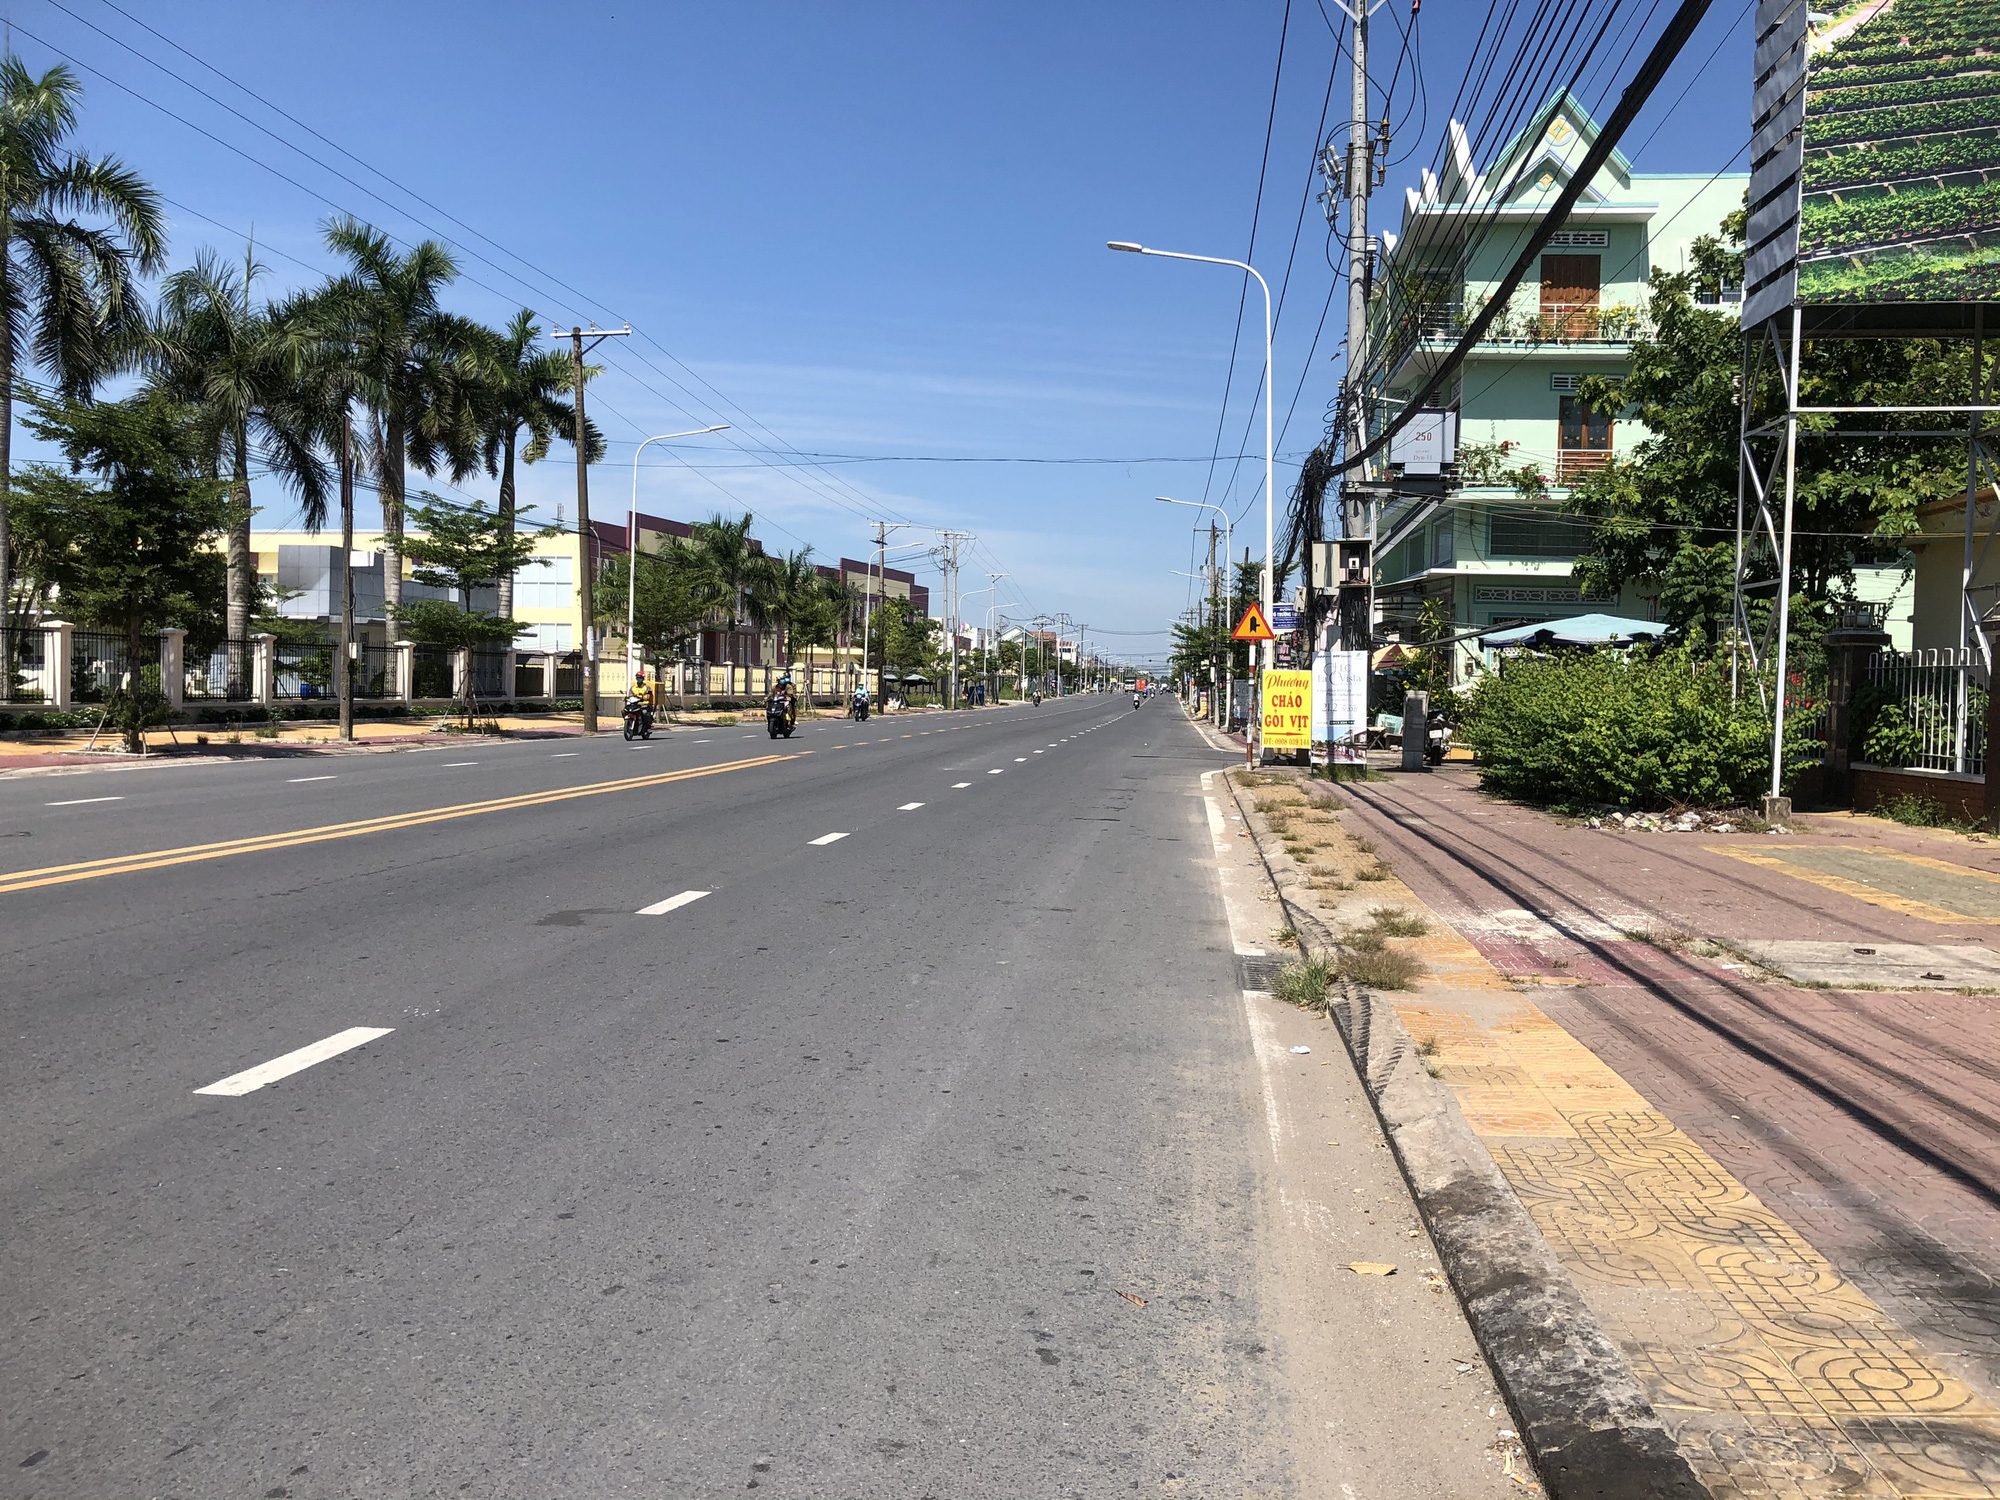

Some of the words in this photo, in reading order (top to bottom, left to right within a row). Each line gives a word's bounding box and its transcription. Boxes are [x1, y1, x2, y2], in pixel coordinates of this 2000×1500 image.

[1415, 431, 1432, 442] 250
[1265, 674, 1309, 690] Phương
[1271, 691, 1303, 708] CHÁO
[1264, 709, 1284, 728] GỎI
[1290, 715, 1309, 731] VỊT
